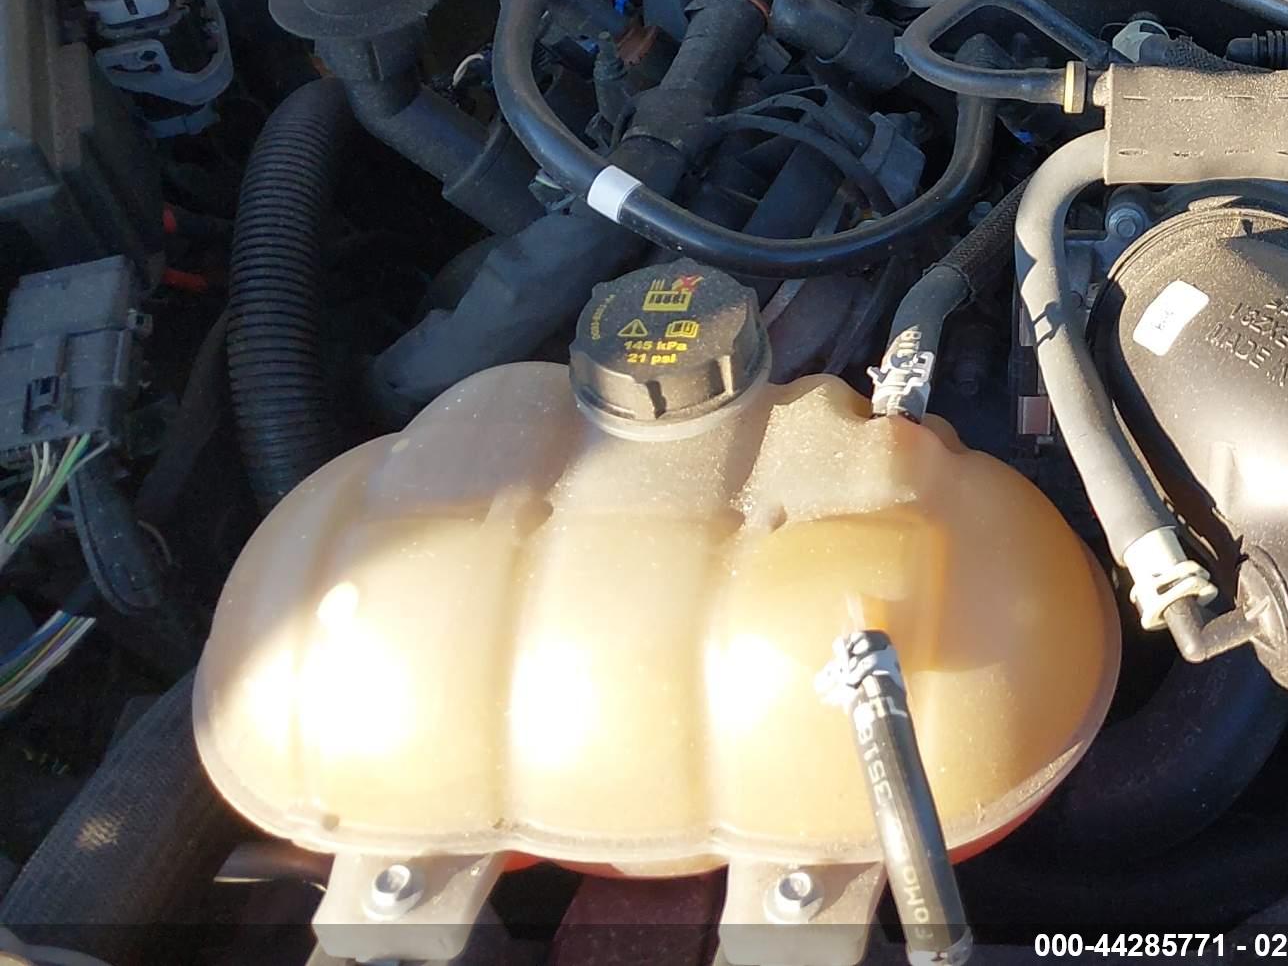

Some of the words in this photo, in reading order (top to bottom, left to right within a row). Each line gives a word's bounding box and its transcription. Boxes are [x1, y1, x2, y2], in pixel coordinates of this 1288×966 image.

[623, 340, 653, 351] 145
[656, 340, 688, 351] kPa
[1205, 321, 1272, 369] MADE
[626, 353, 647, 363] 21
[650, 352, 678, 366] psi
